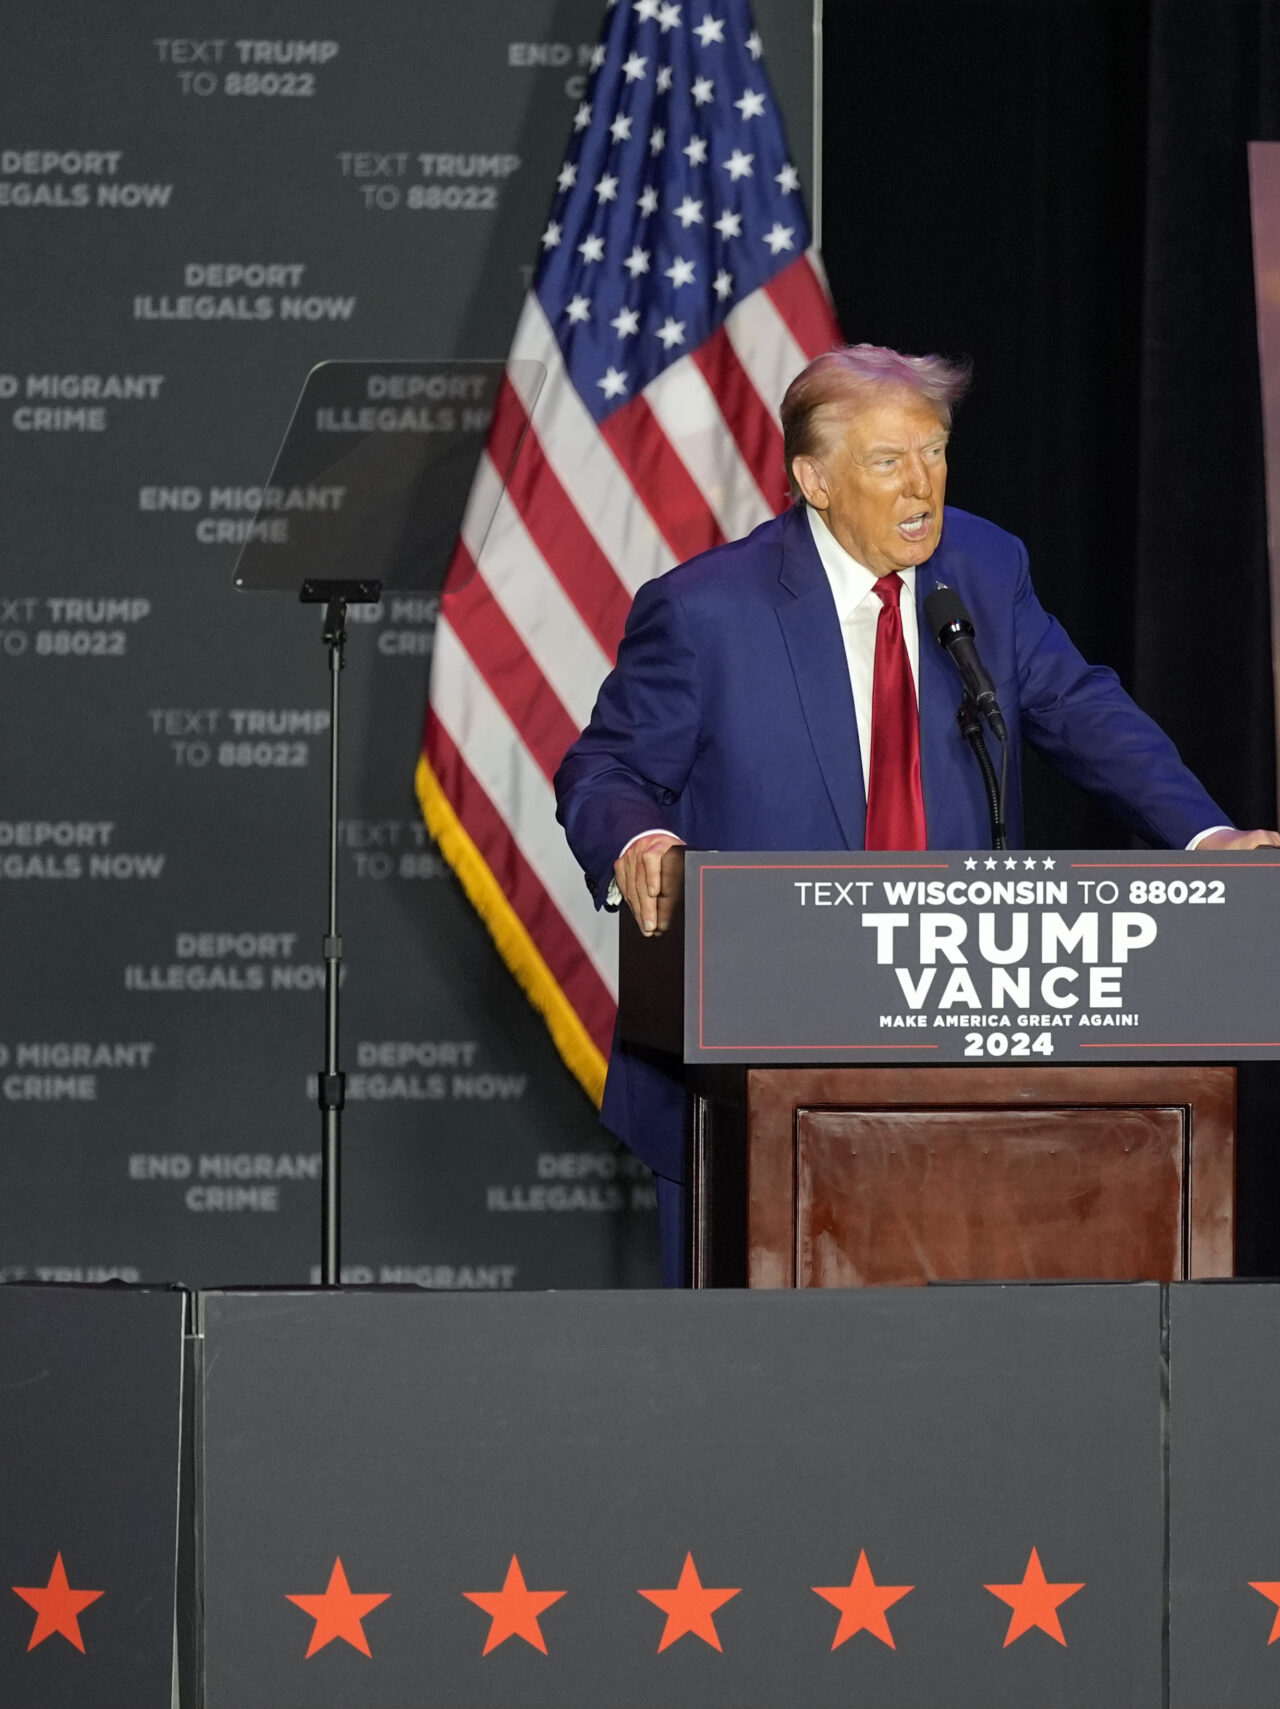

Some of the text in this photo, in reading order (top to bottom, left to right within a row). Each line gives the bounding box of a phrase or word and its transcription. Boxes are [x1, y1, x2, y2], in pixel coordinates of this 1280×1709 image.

[154, 40, 339, 64] TEXT TRUMP
[508, 42, 573, 67] END
[177, 72, 314, 97] TO 88022
[2, 150, 122, 175] DEPORT
[337, 153, 520, 178] TEXT TRUMP
[0, 182, 173, 207] EGALS NOW
[360, 186, 498, 211] TO 88022
[185, 264, 305, 289] DEPORT
[134, 296, 356, 321] ILLEGALS NOW
[26, 374, 165, 400] MIGRANT
[367, 375, 486, 400] DEPORT
[13, 406, 106, 432] CRIME
[316, 406, 456, 432] ILLEGALS
[139, 486, 345, 512] END MIGRANT
[196, 518, 288, 544] CRIME
[1, 599, 151, 624] XT TRUMP
[36, 630, 127, 656] 88022
[148, 709, 331, 736] TEXT TRUMP
[171, 740, 309, 768] TO 88022
[0, 821, 115, 847] DEPORT
[0, 853, 165, 880] GALS NOW
[794, 880, 1226, 906] TEXT WISCONSIN TO 88022
[176, 932, 297, 958] DEPORT
[861, 911, 1158, 966] TRUMP
[125, 964, 265, 991] ILLEGALS
[894, 966, 1123, 1010] VANCE
[879, 1013, 1139, 1028] MAKE AMERICA GREAT AGAIN!
[16, 1042, 154, 1068] MIGRANT
[357, 1041, 478, 1067] DEPORT
[964, 1032, 1054, 1057] 2024
[2, 1074, 97, 1100] CRIME
[306, 1074, 527, 1100] IEGALS NOW
[128, 1153, 323, 1180] END MIGRAN
[185, 1185, 280, 1213] CRIME
